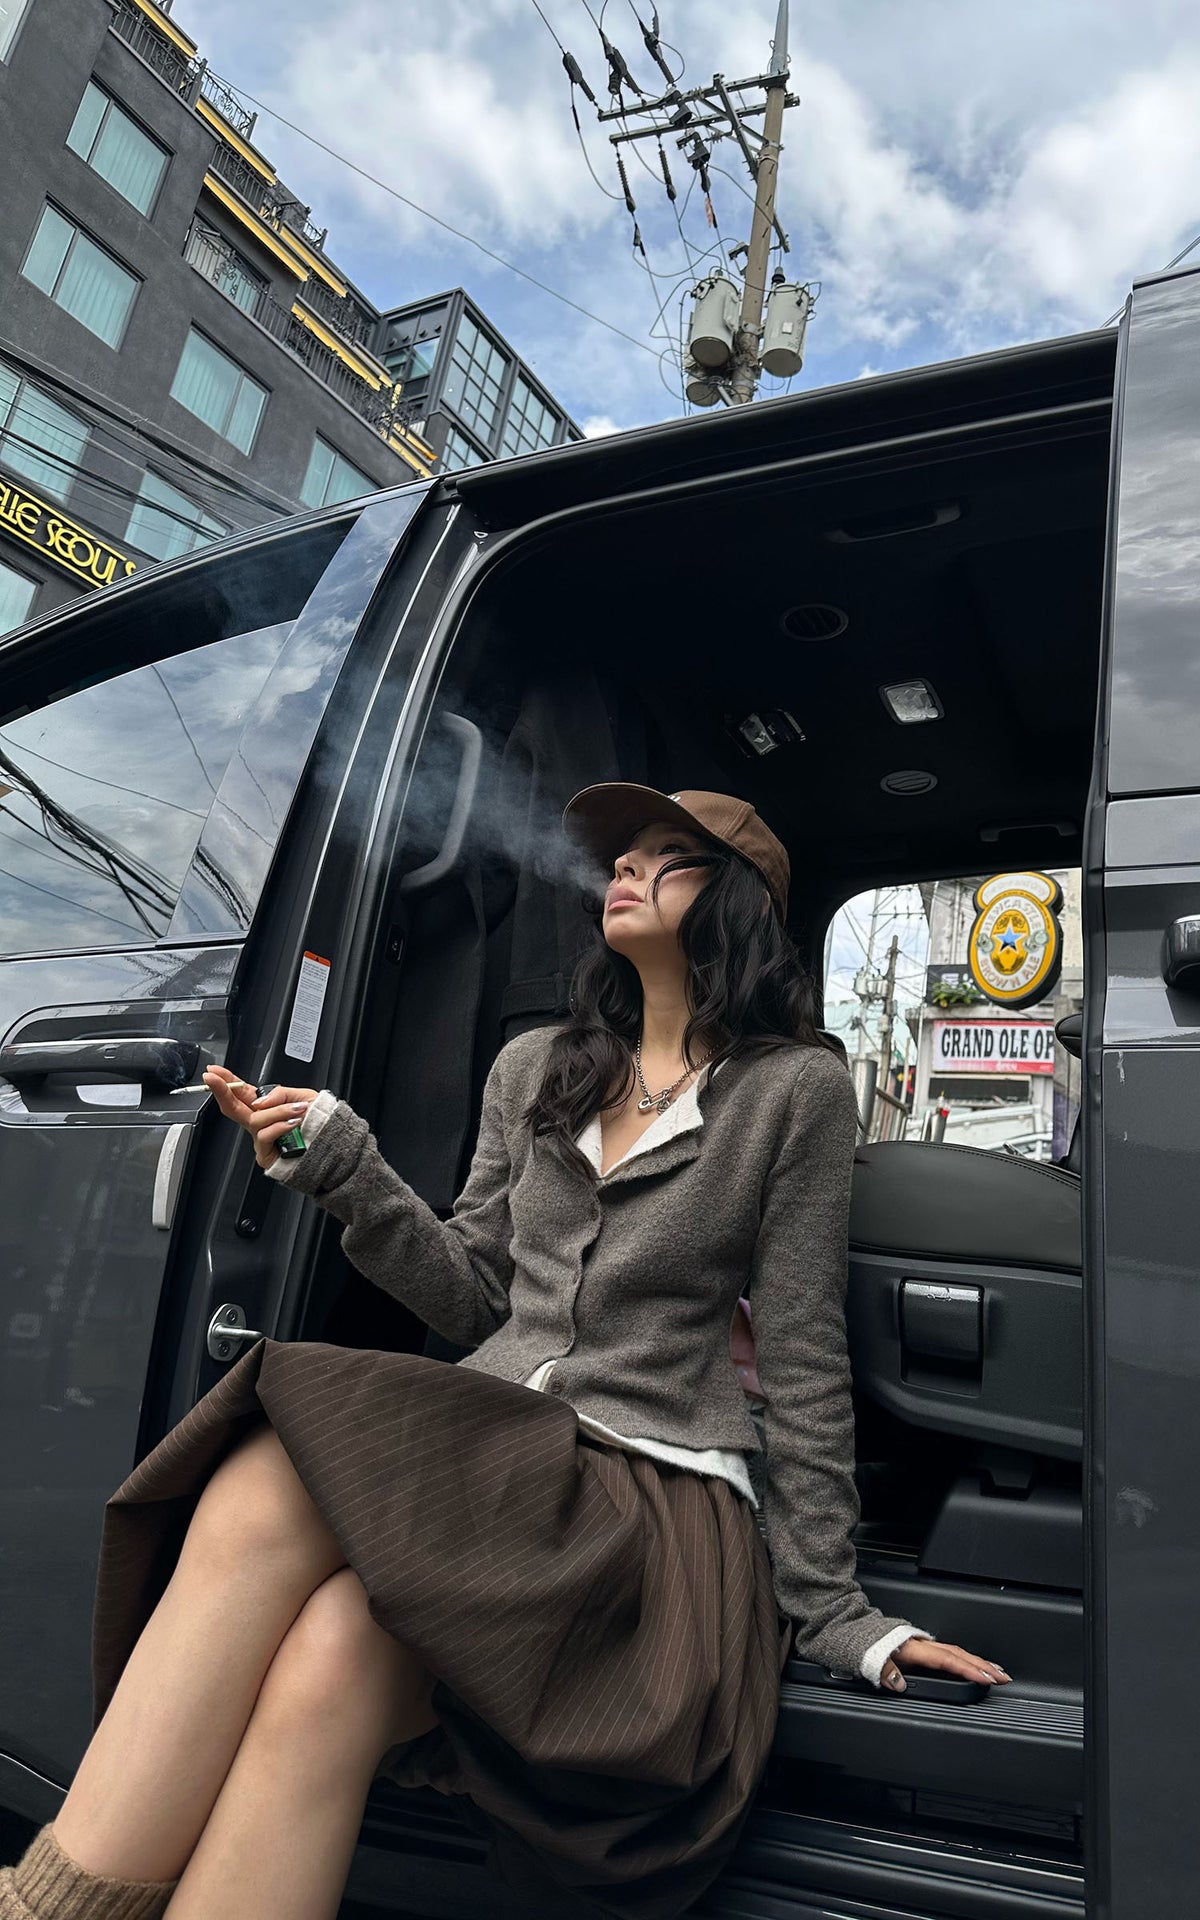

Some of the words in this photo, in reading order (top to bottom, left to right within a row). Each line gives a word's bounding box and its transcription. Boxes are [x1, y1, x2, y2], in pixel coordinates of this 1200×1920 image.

[46, 518, 118, 585] SEOUL
[980, 958, 1021, 988] BROWN
[1022, 956, 1040, 980] ALE
[942, 1028, 994, 1058] GRAND
[1000, 1029, 1029, 1059] OLE
